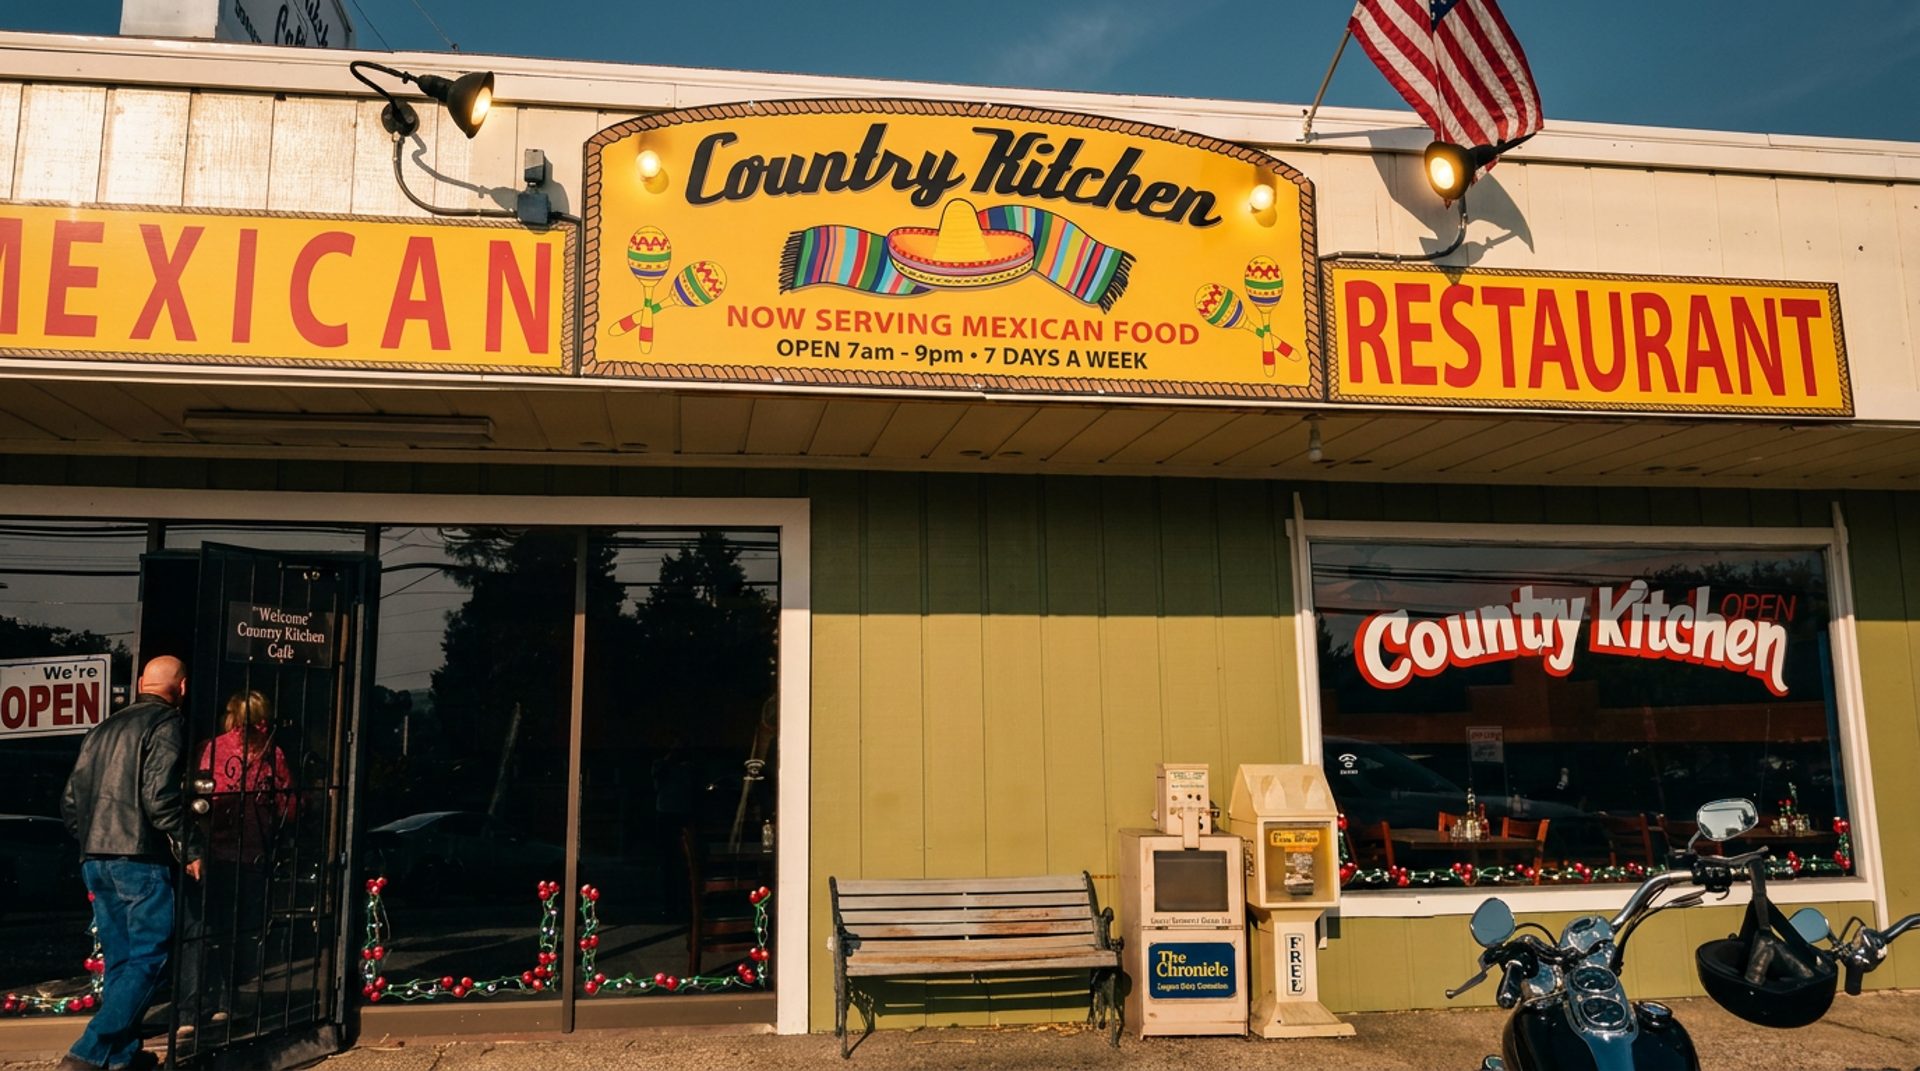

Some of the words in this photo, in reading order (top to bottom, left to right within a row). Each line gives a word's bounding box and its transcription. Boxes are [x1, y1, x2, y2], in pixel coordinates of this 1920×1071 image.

[685, 123, 966, 207] Country
[970, 126, 1222, 227] Kitchen
[0, 218, 552, 355] EXICAN
[727, 305, 806, 330] NOW
[815, 308, 952, 336] SERVING
[962, 315, 1103, 341] MEXICAN
[1114, 320, 1200, 345] FOOD
[1344, 279, 1822, 397] RESTAURANT
[776, 339, 840, 358] OPEN
[847, 342, 894, 360] 7am
[915, 345, 963, 366] 9pm
[984, 347, 996, 364] 7
[1003, 348, 1060, 367] DAYS
[1066, 350, 1081, 367] A
[1086, 350, 1148, 369] WEEK
[1720, 592, 1797, 622] OPEN
[1355, 585, 1586, 689] Country
[1589, 579, 1790, 697] Kitchen
[43, 665, 98, 680] We're
[1, 682, 100, 730] OPEN
[1156, 961, 1229, 977] Chronicle
[1157, 950, 1187, 963] The
[1290, 936, 1303, 993] FREE
